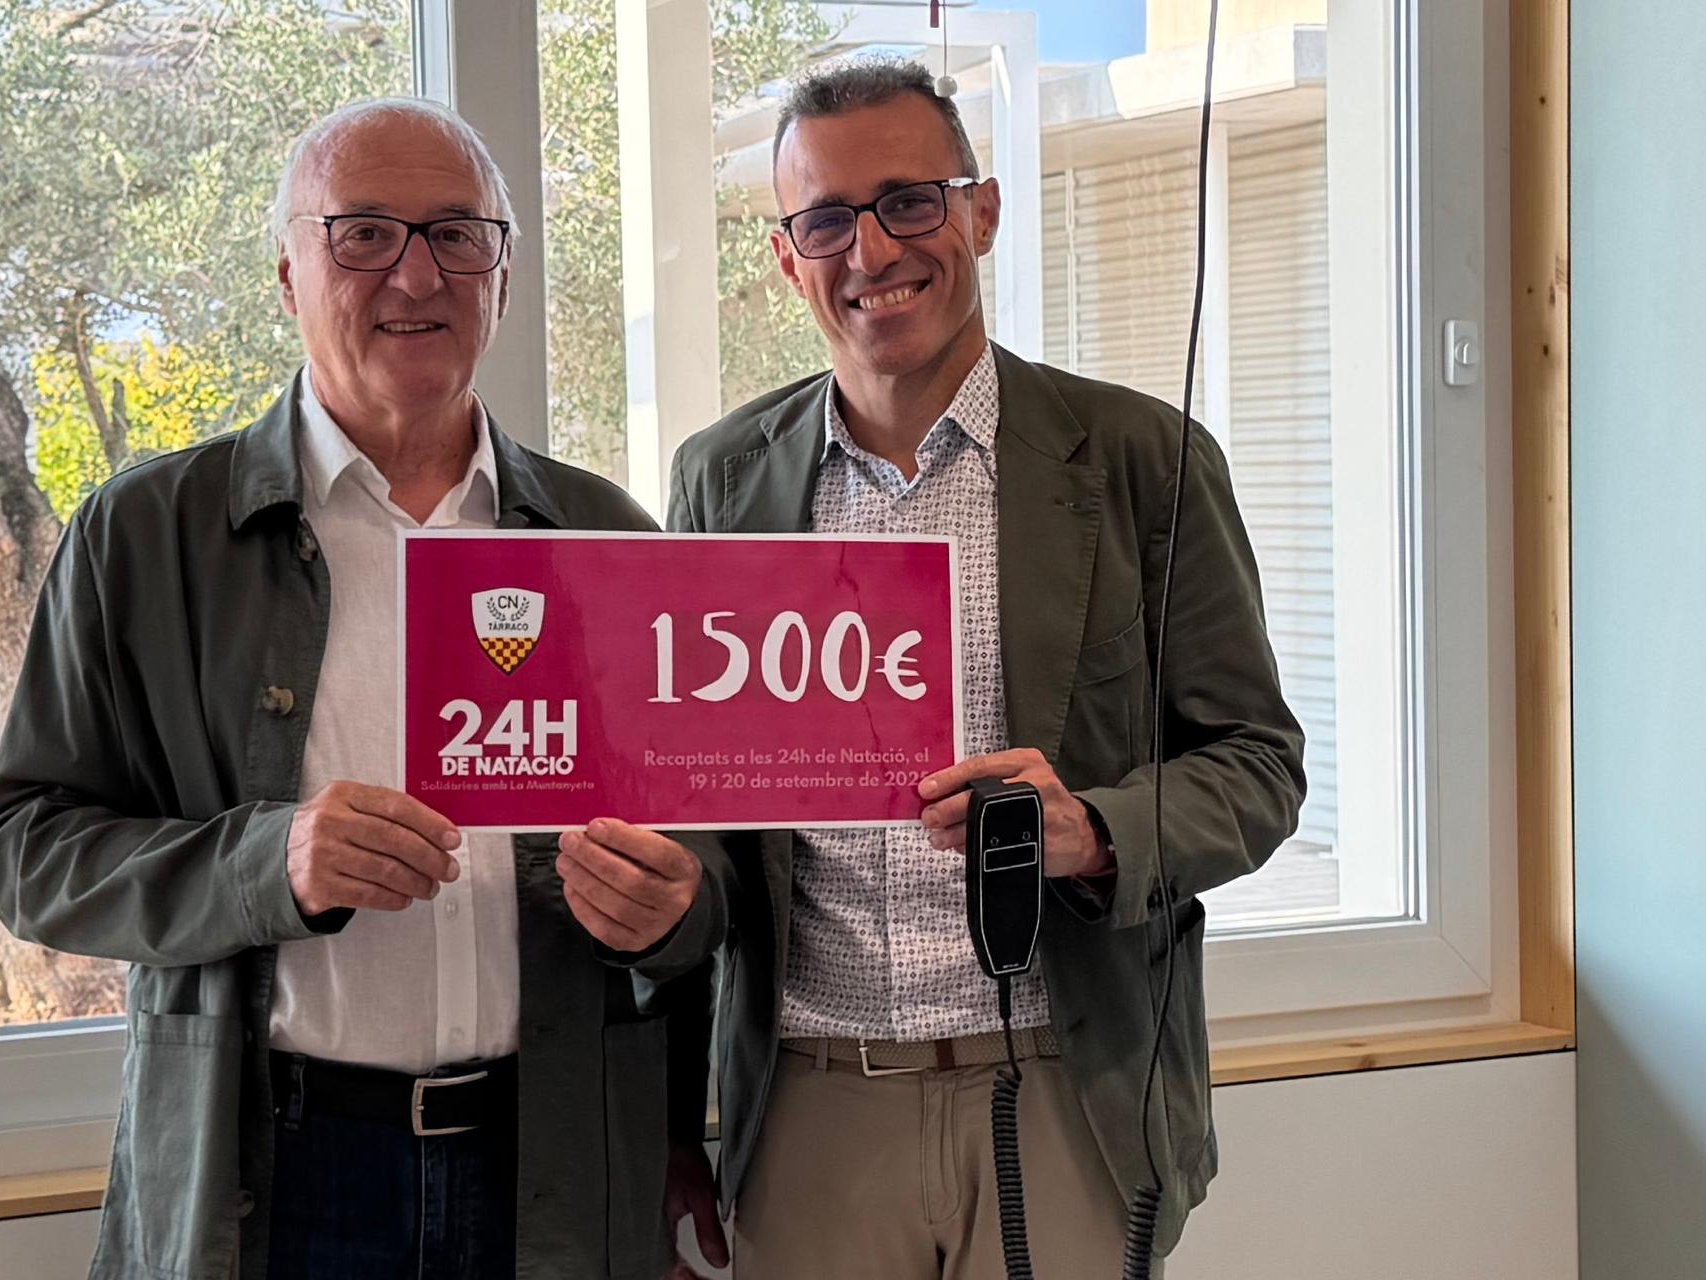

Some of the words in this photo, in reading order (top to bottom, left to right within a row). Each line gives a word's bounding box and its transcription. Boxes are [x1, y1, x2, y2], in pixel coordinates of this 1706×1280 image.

[498, 595, 519, 609] CN
[647, 610, 927, 703] 1500€
[438, 699, 578, 757] 24H
[442, 757, 469, 776] DE
[644, 750, 730, 770] Recaptats
[734, 755, 745, 765] a
[750, 749, 773, 764] les
[777, 748, 811, 764] 24h
[815, 748, 836, 763] de
[840, 747, 910, 765] Natació,
[914, 747, 930, 763] el
[688, 773, 707, 789] 19
[712, 773, 717, 788] i
[721, 773, 746, 788] 20
[750, 772, 771, 788] de
[775, 771, 854, 788] setembre
[858, 771, 879, 787] de
